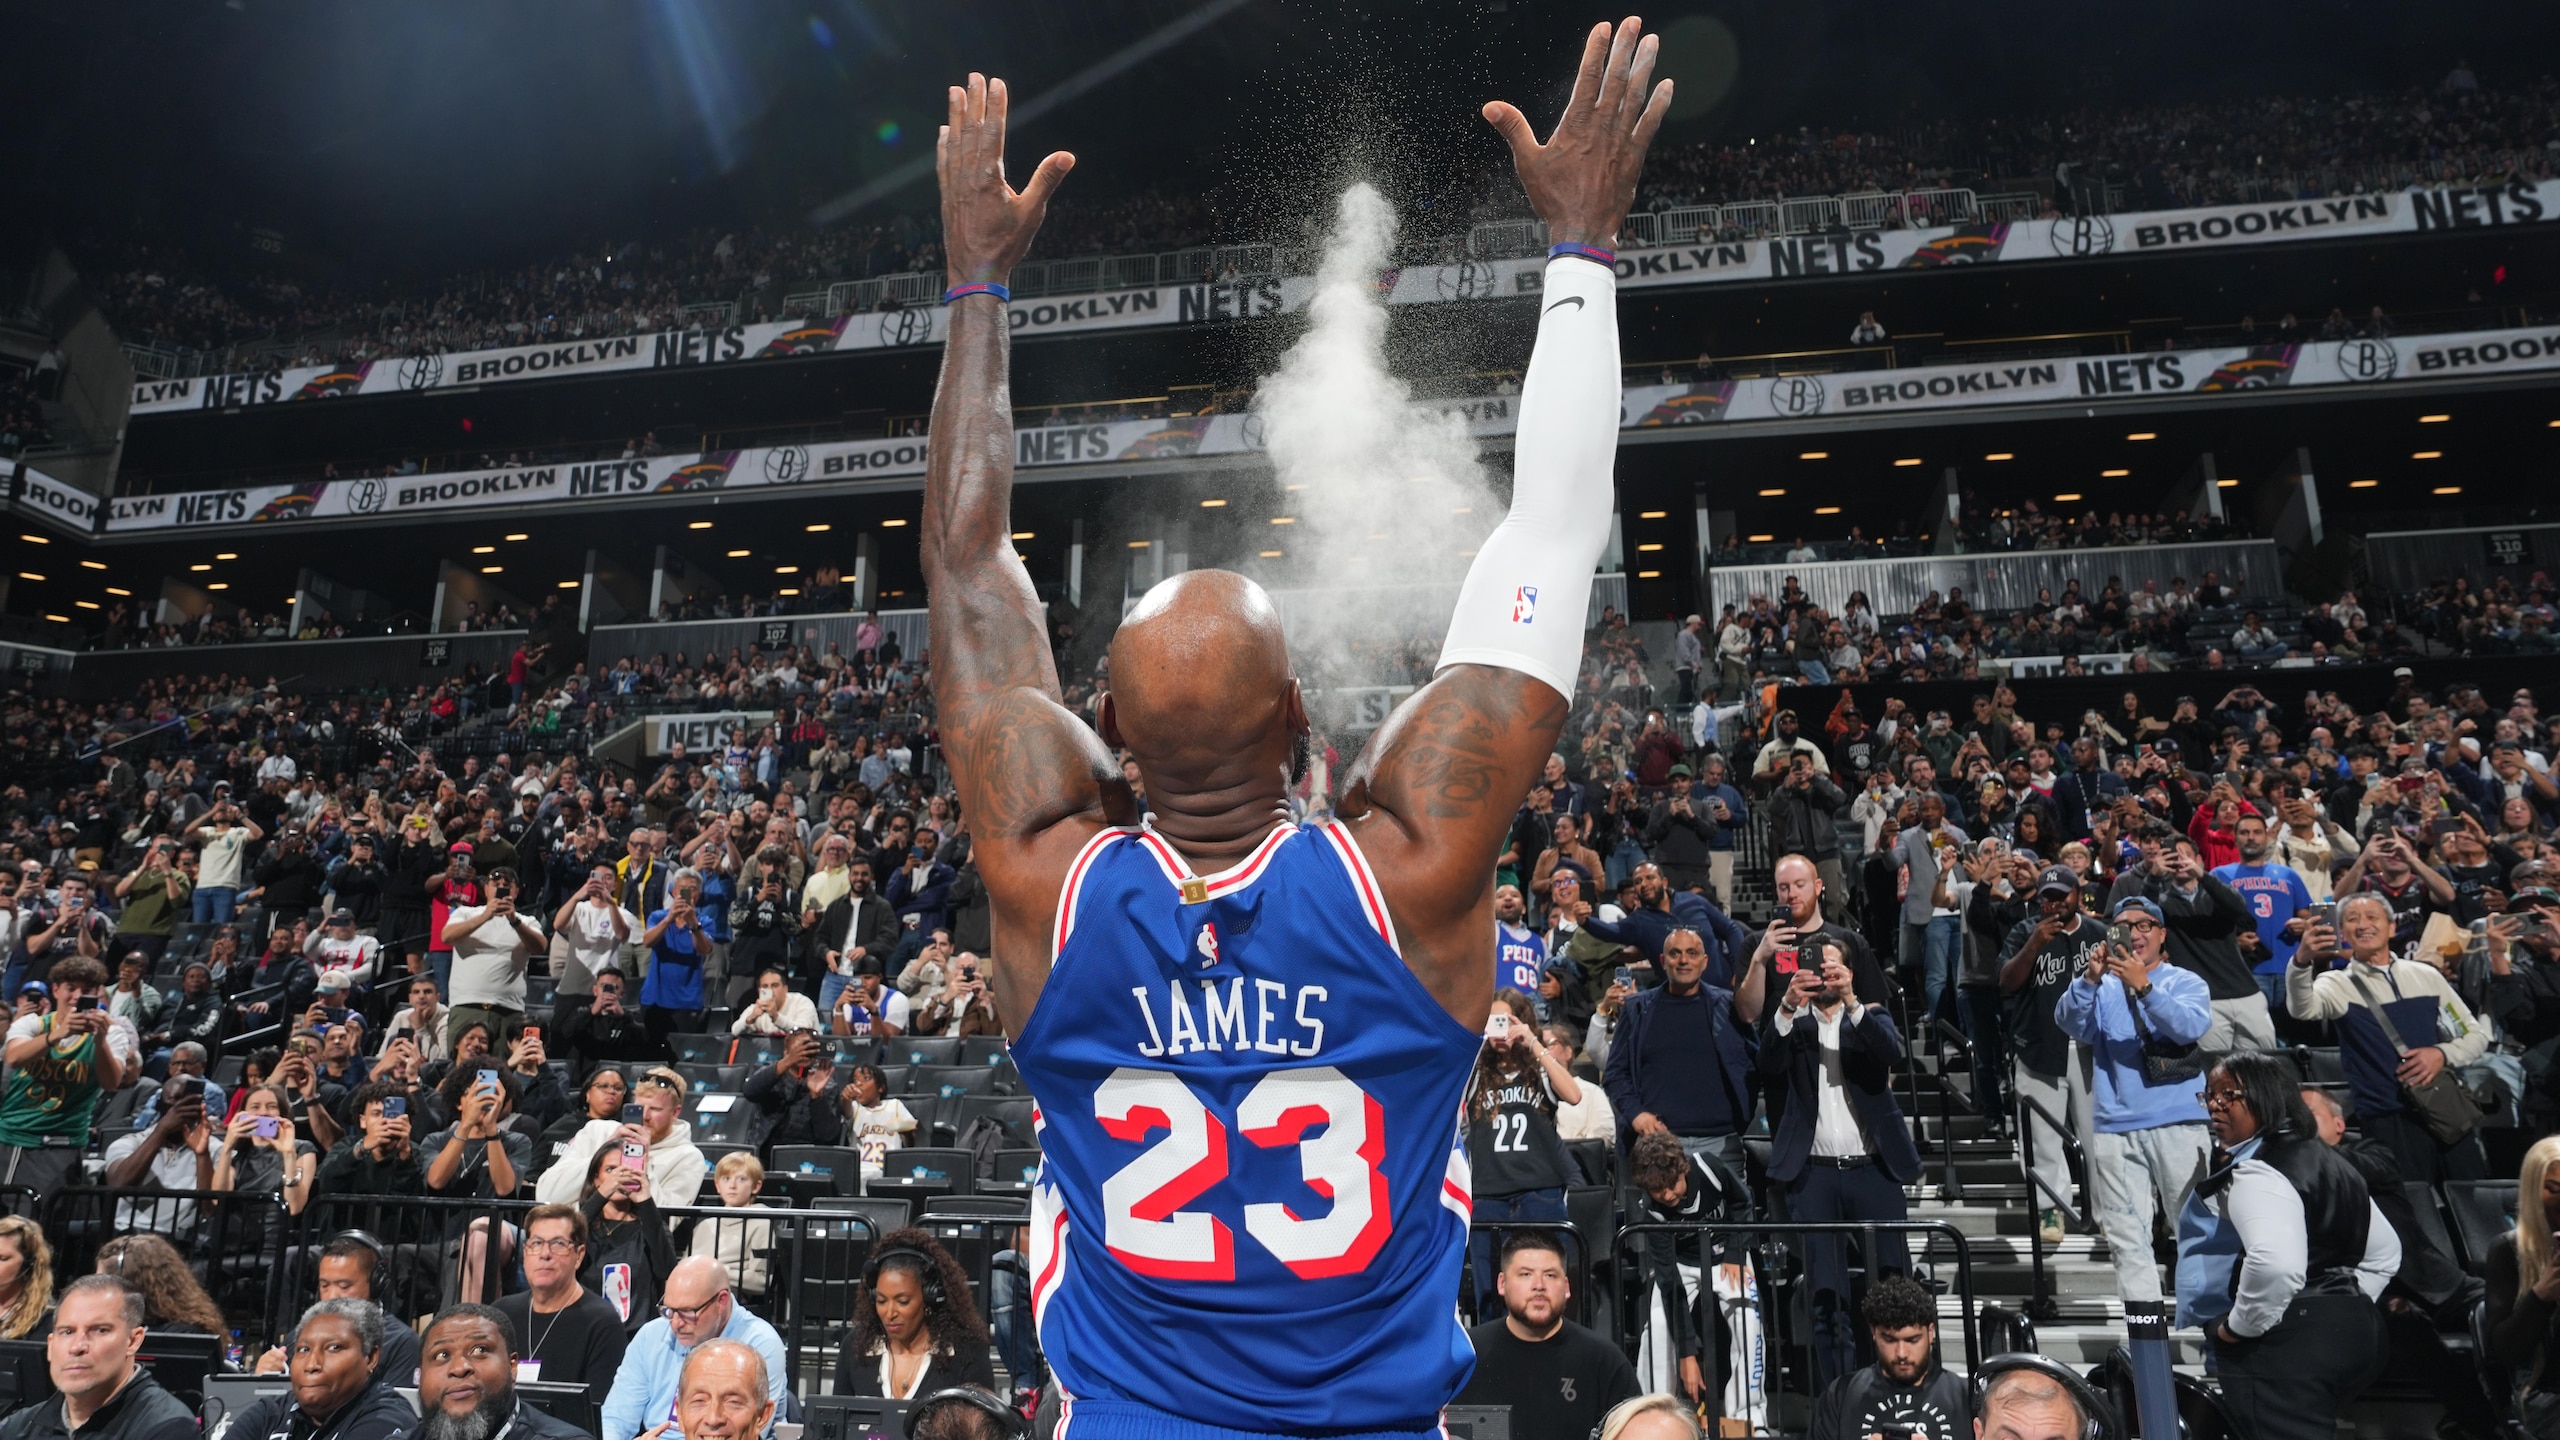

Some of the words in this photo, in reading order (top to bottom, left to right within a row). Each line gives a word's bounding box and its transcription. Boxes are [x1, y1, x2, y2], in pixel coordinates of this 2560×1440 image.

[2136, 196, 2388, 248] BROOKLYN
[2411, 178, 2544, 231] NETS
[1768, 231, 1885, 278] NETS
[1009, 291, 1158, 330] OOKLYN
[1179, 278, 1282, 322] NETS
[457, 337, 638, 383] BROOKLYN
[653, 325, 745, 369] NETS
[202, 371, 282, 409] NETS
[1842, 363, 2057, 407] BROOKLYN
[2075, 356, 2184, 395] NETS
[1019, 425, 1110, 464] NETS
[398, 468, 557, 506] BROOKLYN
[568, 460, 649, 497] NETS
[176, 491, 248, 524] NETS
[2493, 540, 2523, 553] 110
[427, 646, 447, 658] 106
[765, 629, 787, 641] 107
[665, 718, 736, 751] NETS
[2229, 876, 2291, 896] PHILA
[2252, 893, 2274, 918] 3
[1131, 976, 1329, 1057] JAMES
[26, 1082, 67, 1112] 99
[1492, 1112, 1530, 1153] 22
[861, 1141, 888, 1164] 23
[1092, 1066, 1394, 1282] 23
[1559, 1376, 1578, 1402] 76
